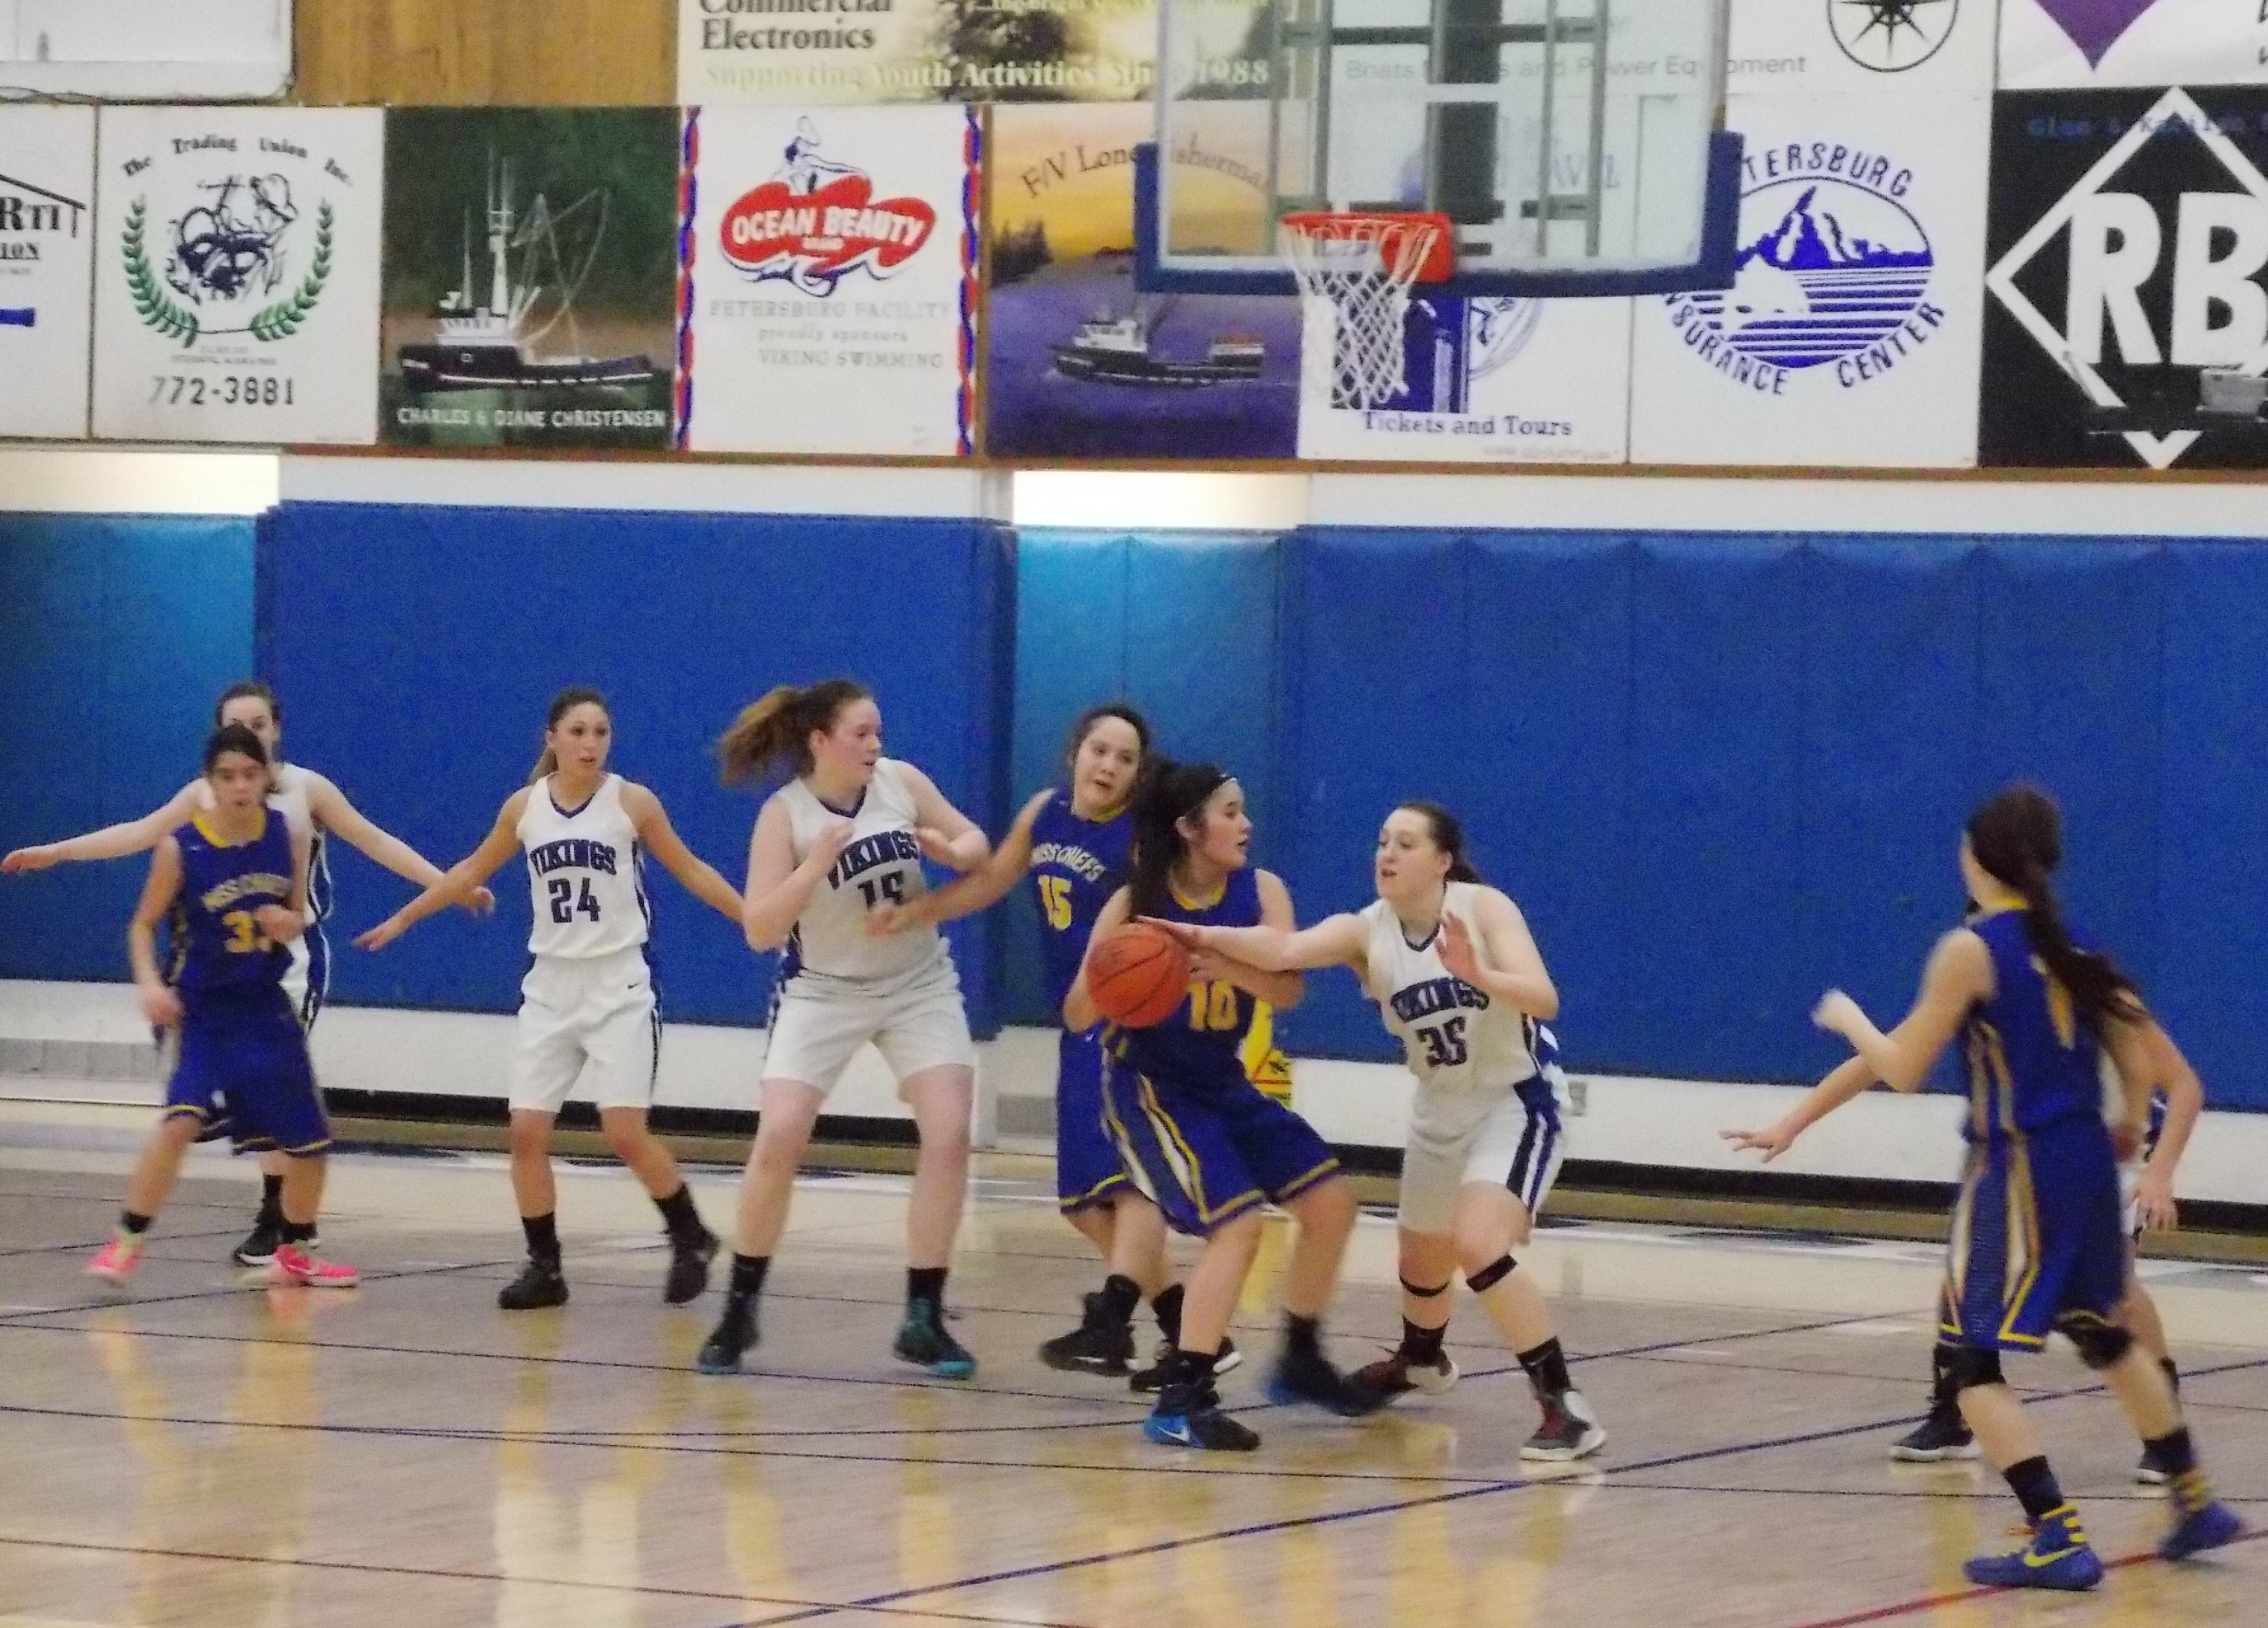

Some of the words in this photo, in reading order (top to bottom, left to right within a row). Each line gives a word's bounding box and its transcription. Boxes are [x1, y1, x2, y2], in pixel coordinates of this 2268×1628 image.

[701, 16, 876, 49] Electronics
[705, 62, 861, 93] Supporting
[867, 61, 952, 87] Youth
[959, 61, 1098, 87] Activities
[1197, 59, 1268, 85] 1988
[1578, 57, 1657, 75] Pwer
[1665, 55, 1806, 78] Eqpment
[171, 133, 237, 154] Trading
[259, 137, 308, 158] Union
[1021, 150, 1067, 199] F/V
[1742, 143, 1914, 197] TERSBURG
[732, 206, 817, 245] OCEAN
[822, 204, 925, 247] BEAUTY
[709, 299, 846, 318] PETERSBURG
[855, 302, 950, 319] FACILITY
[759, 349, 830, 366] VIKING
[837, 350, 943, 369] SWIMMING
[1665, 292, 1790, 395] SURANCE
[1836, 302, 1945, 388] CENTER
[148, 376, 294, 406] 772-3881
[398, 407, 470, 425] CHARLES
[494, 408, 546, 427] DIANE
[551, 409, 666, 428] CHRISTENSEN
[1364, 411, 1445, 434] Tickets
[1452, 415, 1496, 434] and
[1504, 415, 1572, 436] Tours
[530, 838, 617, 877] VIKINGS
[548, 877, 601, 924] 24
[1037, 875, 1073, 931] 15
[1190, 978, 1239, 1031] 10
[1390, 977, 1490, 1024] VIKINGS
[1415, 1016, 1468, 1068] 35
